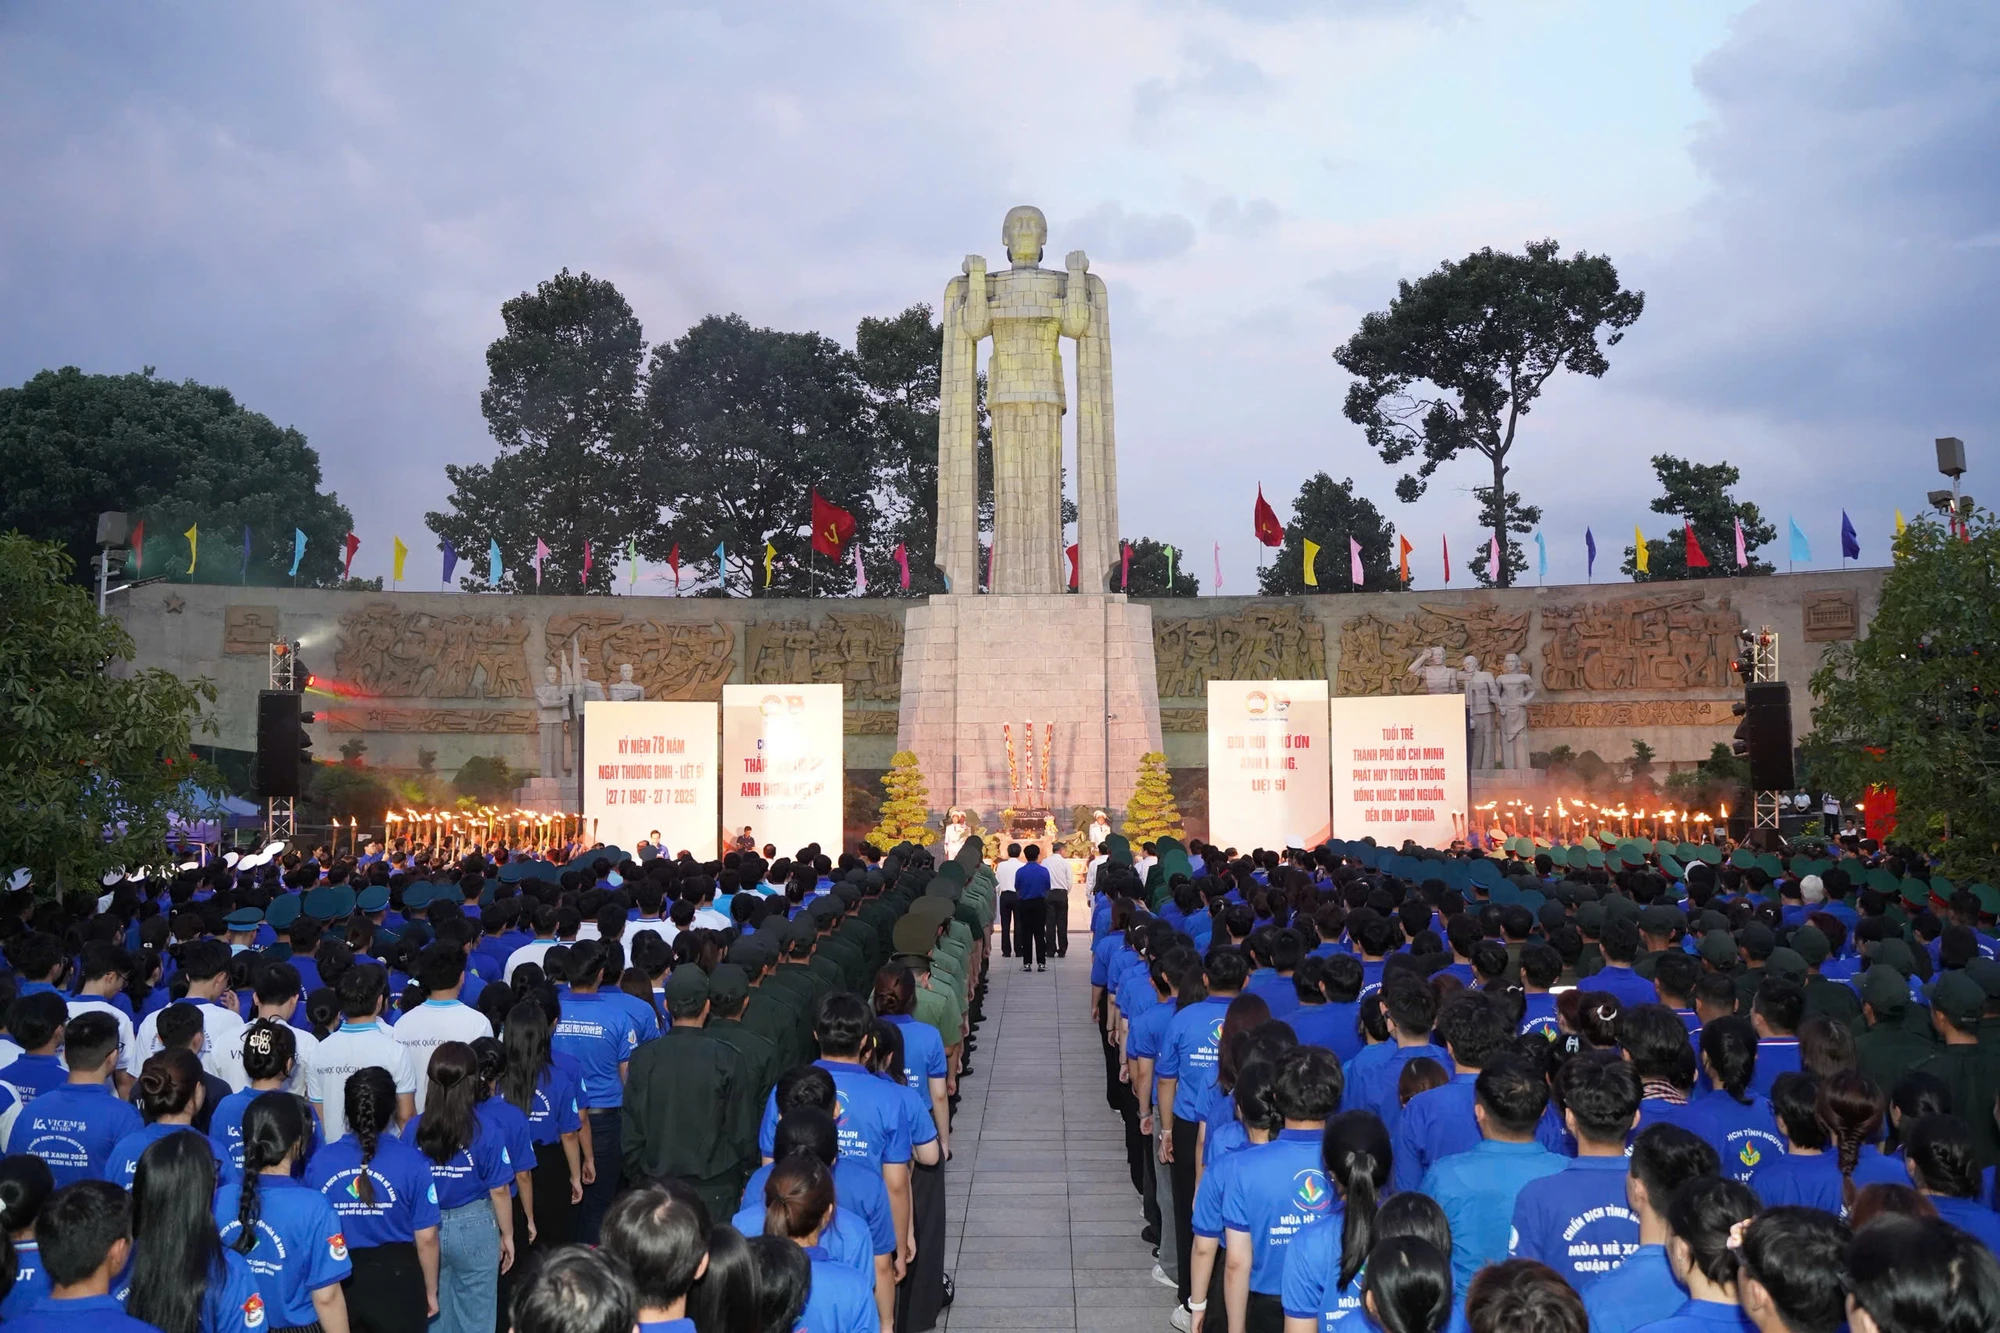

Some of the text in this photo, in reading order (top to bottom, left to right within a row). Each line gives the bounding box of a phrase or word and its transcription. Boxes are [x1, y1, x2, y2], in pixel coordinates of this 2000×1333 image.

[1382, 723, 1414, 740] TUỔI TRẺ
[630, 736, 650, 757] NIỆM
[653, 736, 664, 754] 78
[666, 737, 684, 754] NĂM
[1294, 734, 1310, 748] ƠN
[1353, 746, 1377, 761] THÀNH
[1380, 744, 1394, 760] PHỐ
[1423, 748, 1444, 760] MINH
[598, 762, 620, 780] NGÀY
[621, 763, 652, 780] THƯƠNG
[654, 764, 672, 780] BINH
[1353, 767, 1372, 781] PHÁT
[1373, 768, 1388, 780] HUY
[1420, 764, 1446, 780] THỐNG
[741, 782, 760, 796] ANH
[1354, 786, 1374, 801] UỐNG
[1376, 787, 1396, 801] NƯỚC
[1399, 786, 1415, 800] NHỚ
[1382, 808, 1392, 822] ƠN
[1394, 808, 1410, 822] ĐÁP
[1412, 807, 1435, 822] NGHĨA
[48, 1118, 78, 1128] VICEM
[1743, 1128, 1762, 1136] TÌNH
[1280, 1214, 1301, 1224] MÙA
[1562, 1217, 1586, 1241] CHIẾN
[1583, 1207, 1605, 1222] DỊCH
[1605, 1204, 1629, 1218] TÌNH
[1568, 1241, 1600, 1256] MÙA
[1602, 1240, 1620, 1255] HÈ
[1574, 1258, 1610, 1274] QUẬN
[1338, 1296, 1361, 1308] MÙA
